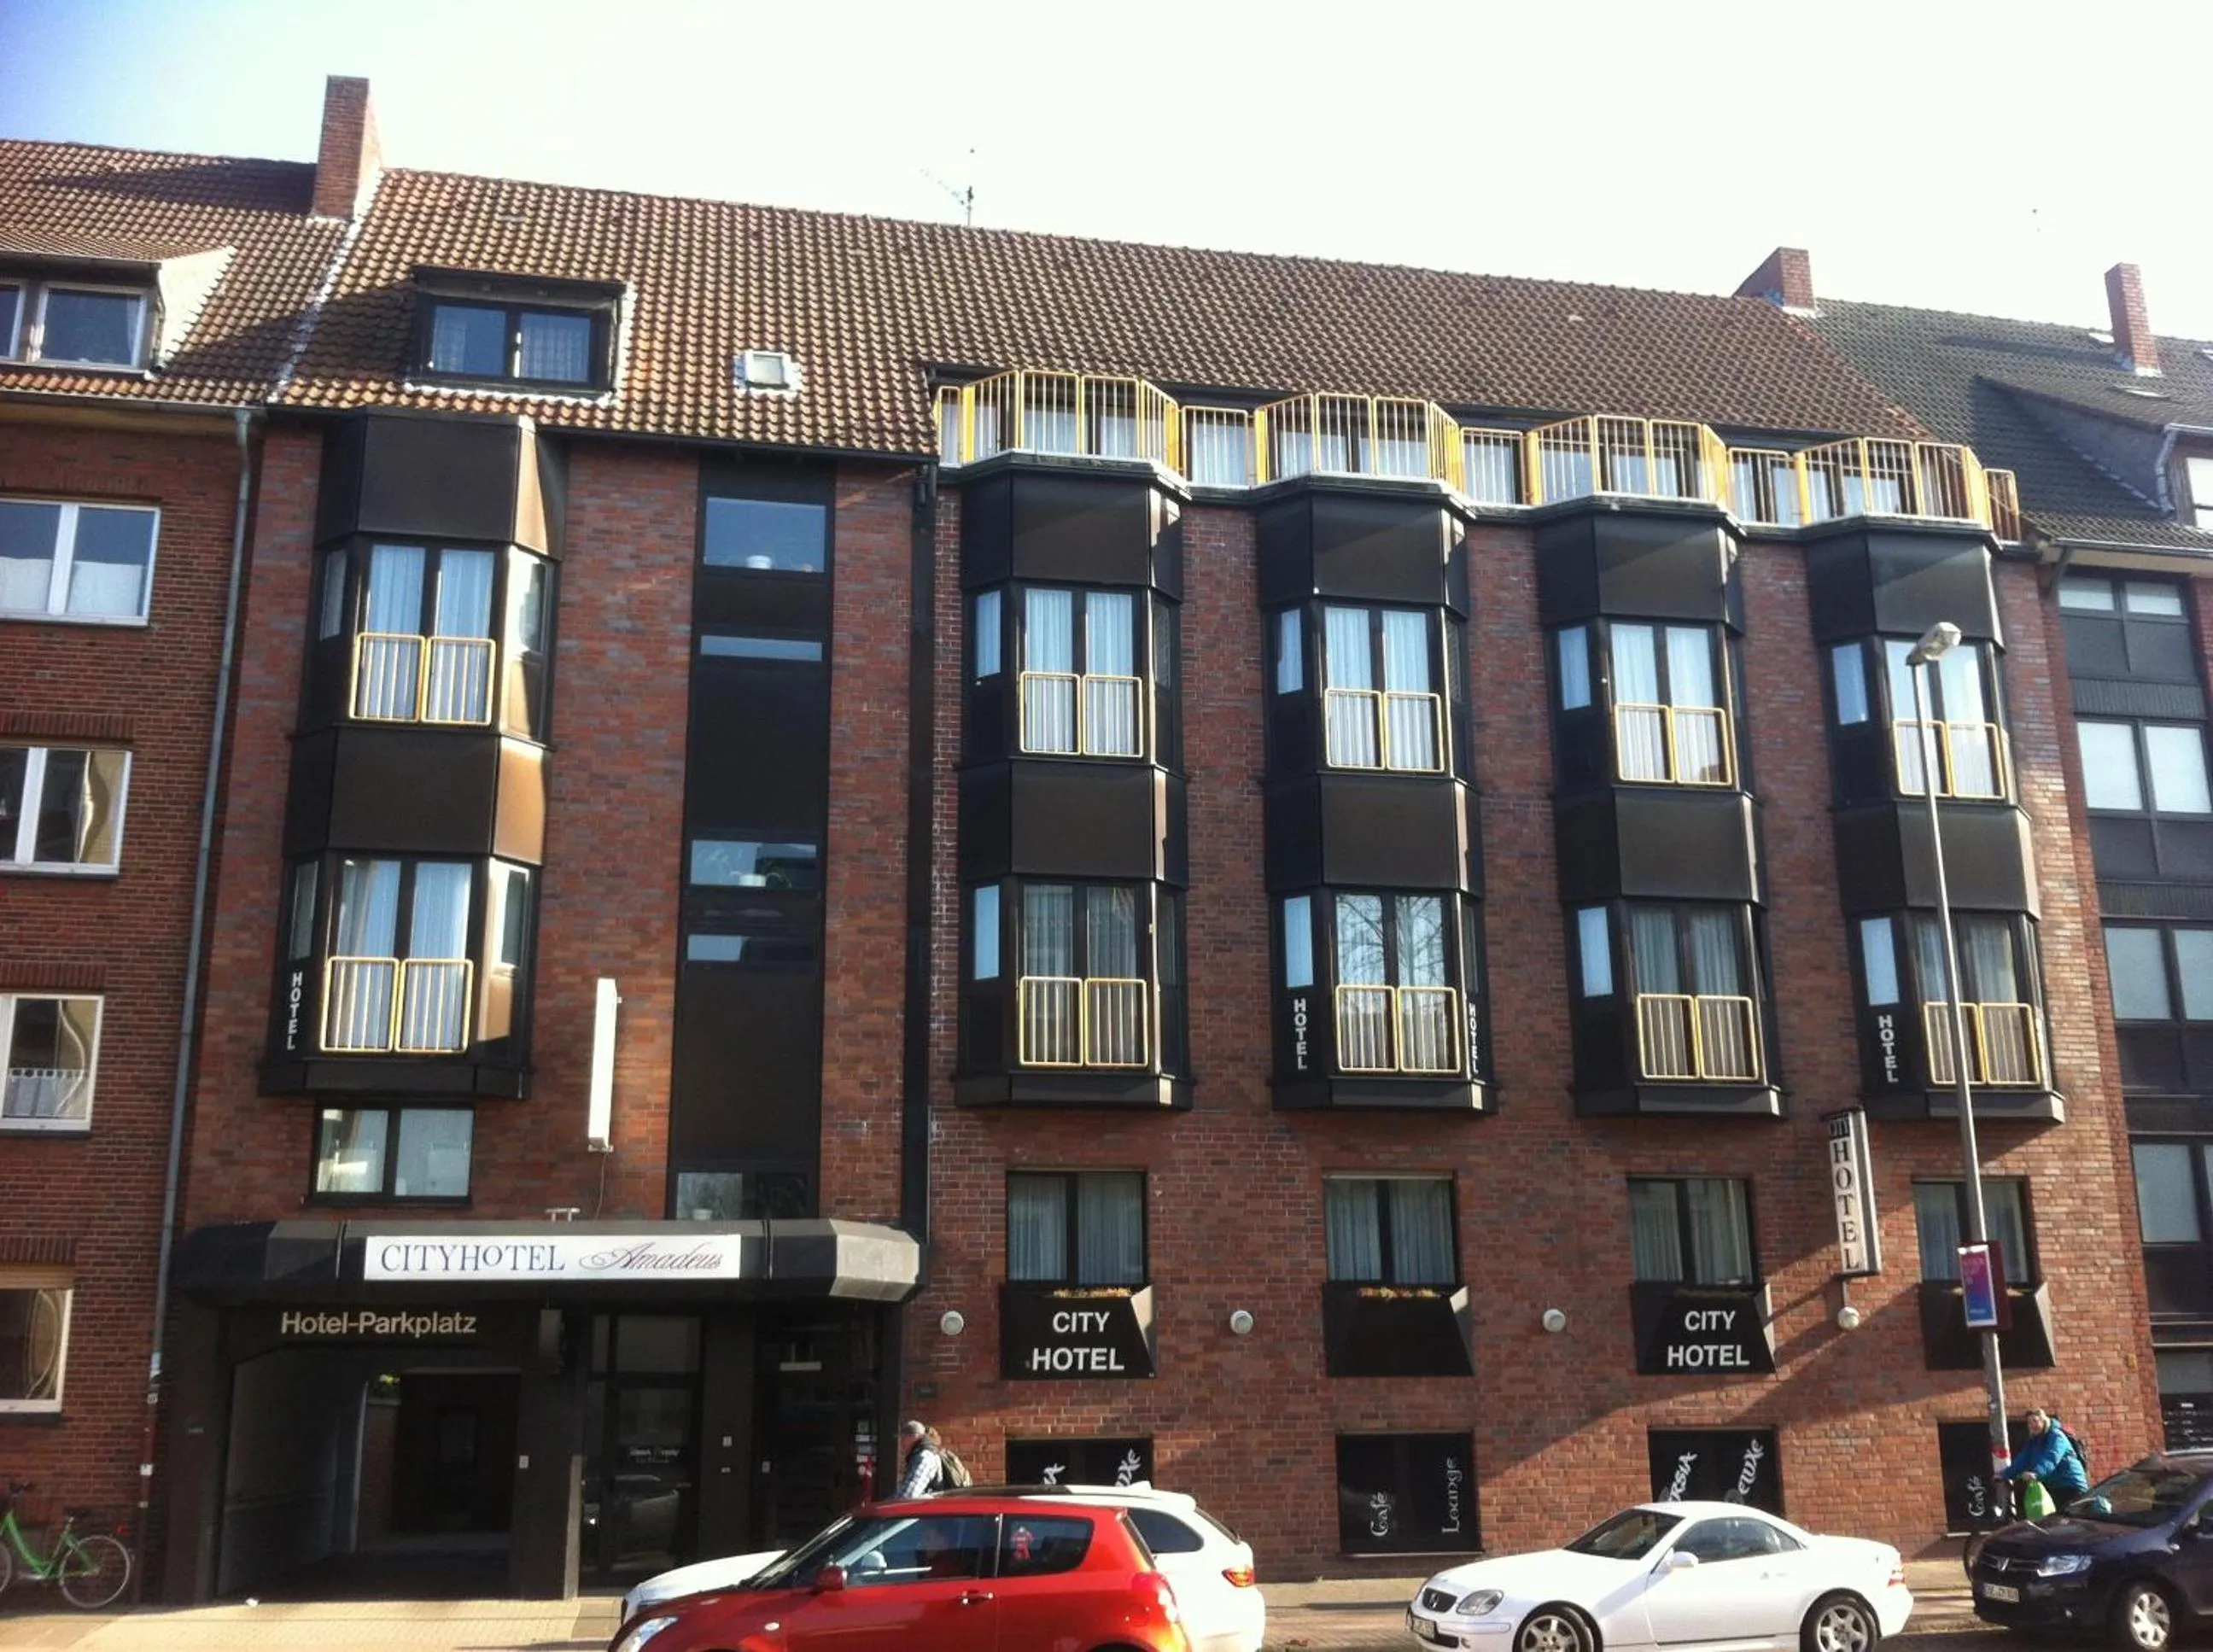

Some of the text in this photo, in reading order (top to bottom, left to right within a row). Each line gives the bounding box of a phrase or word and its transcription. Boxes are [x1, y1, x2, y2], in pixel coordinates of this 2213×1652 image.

[287, 971, 303, 1051] HOTEL
[1293, 997, 1308, 1071] HOTEL
[1469, 1002, 1480, 1074] HOTEL
[1877, 1014, 1900, 1083] HOTEL
[1833, 1141, 1860, 1270] HOTEL
[381, 1240, 725, 1272] CITYHOTEL Amadeus
[280, 1311, 477, 1339] Hotel-Parkplatz
[1052, 1311, 1110, 1334] CITY
[1685, 1310, 1736, 1331] CITY
[1031, 1346, 1125, 1371] HOTEL
[1667, 1344, 1750, 1367] HOTEL
[1441, 1456, 1463, 1533] Lounge
